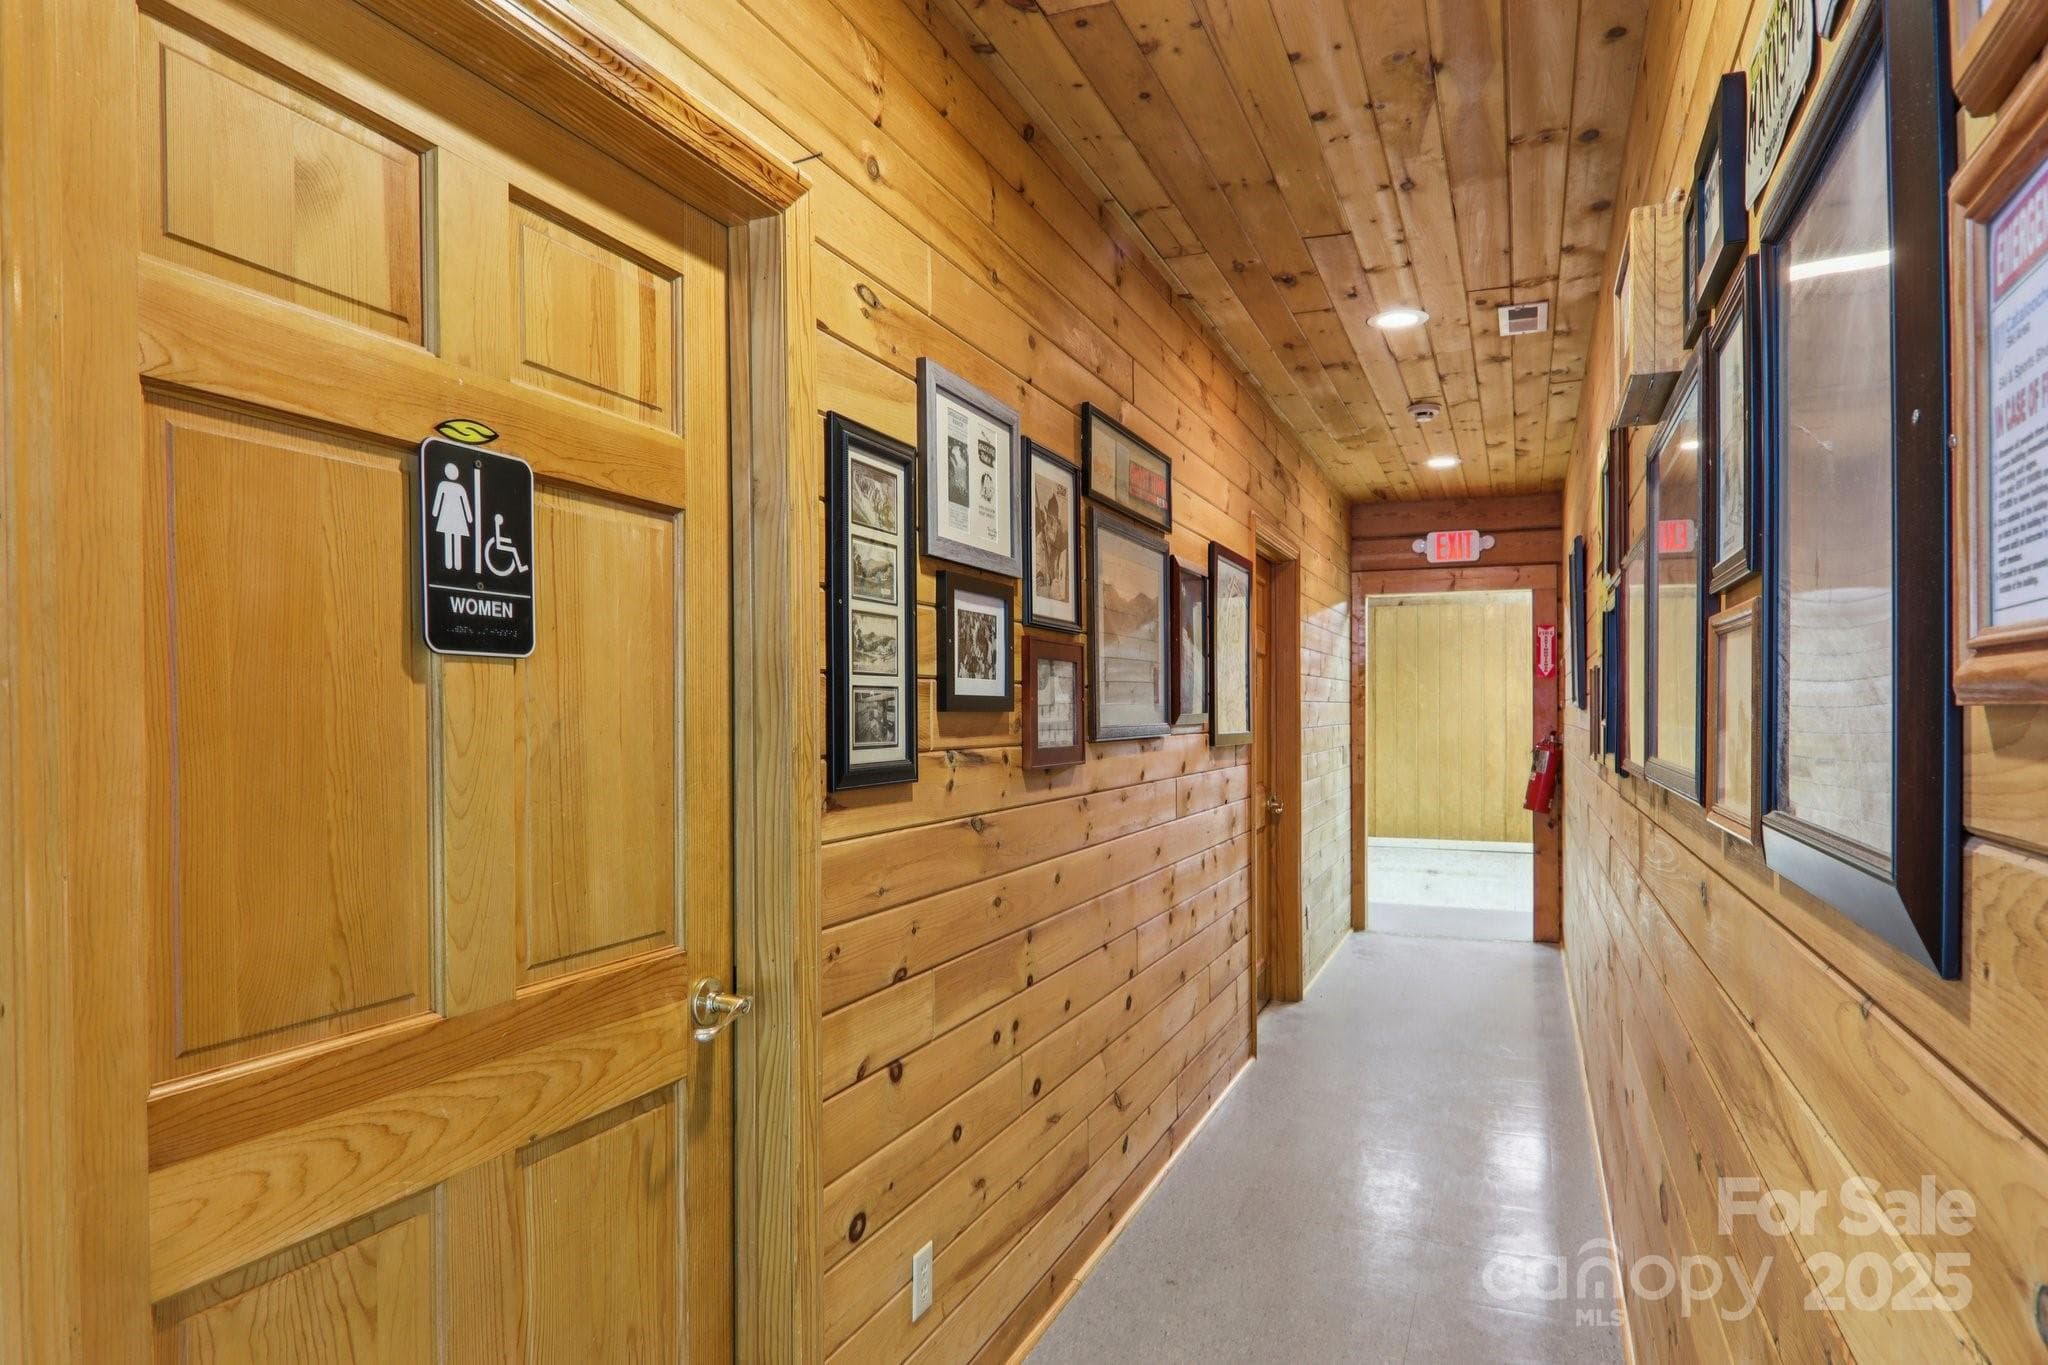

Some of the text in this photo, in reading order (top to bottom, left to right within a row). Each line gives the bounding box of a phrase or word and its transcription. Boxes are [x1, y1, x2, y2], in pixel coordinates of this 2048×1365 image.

[2005, 387, 2026, 431] CASE
[2028, 377, 2039, 417] OF
[1436, 531, 1473, 560] EXIT
[450, 596, 513, 618] WOMEN
